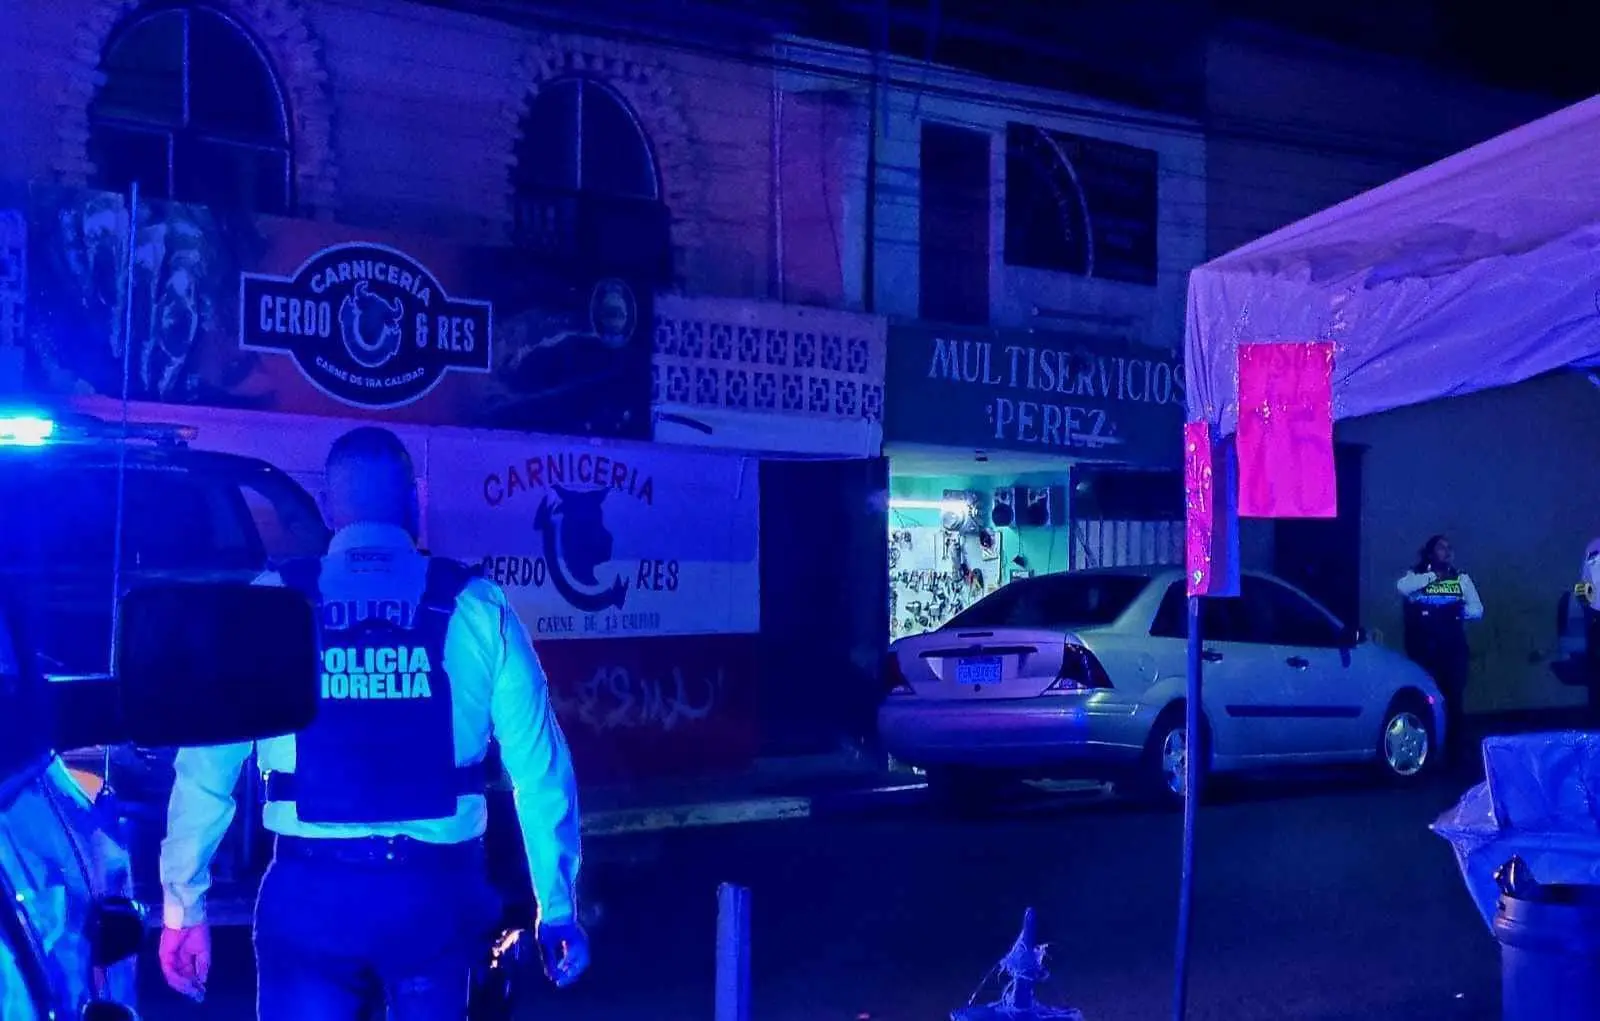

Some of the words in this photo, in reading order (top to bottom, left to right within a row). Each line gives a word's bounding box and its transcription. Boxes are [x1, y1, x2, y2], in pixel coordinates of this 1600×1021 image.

[259, 294, 331, 338] CERDO
[437, 315, 475, 352] RES
[316, 356, 348, 381] CARNE
[349, 374, 363, 386] DE
[384, 367, 425, 387] CALIDAD
[927, 337, 1186, 406] MULTISERVICIOS
[483, 452, 654, 507] CARNICERIA
[636, 558, 681, 592] RES
